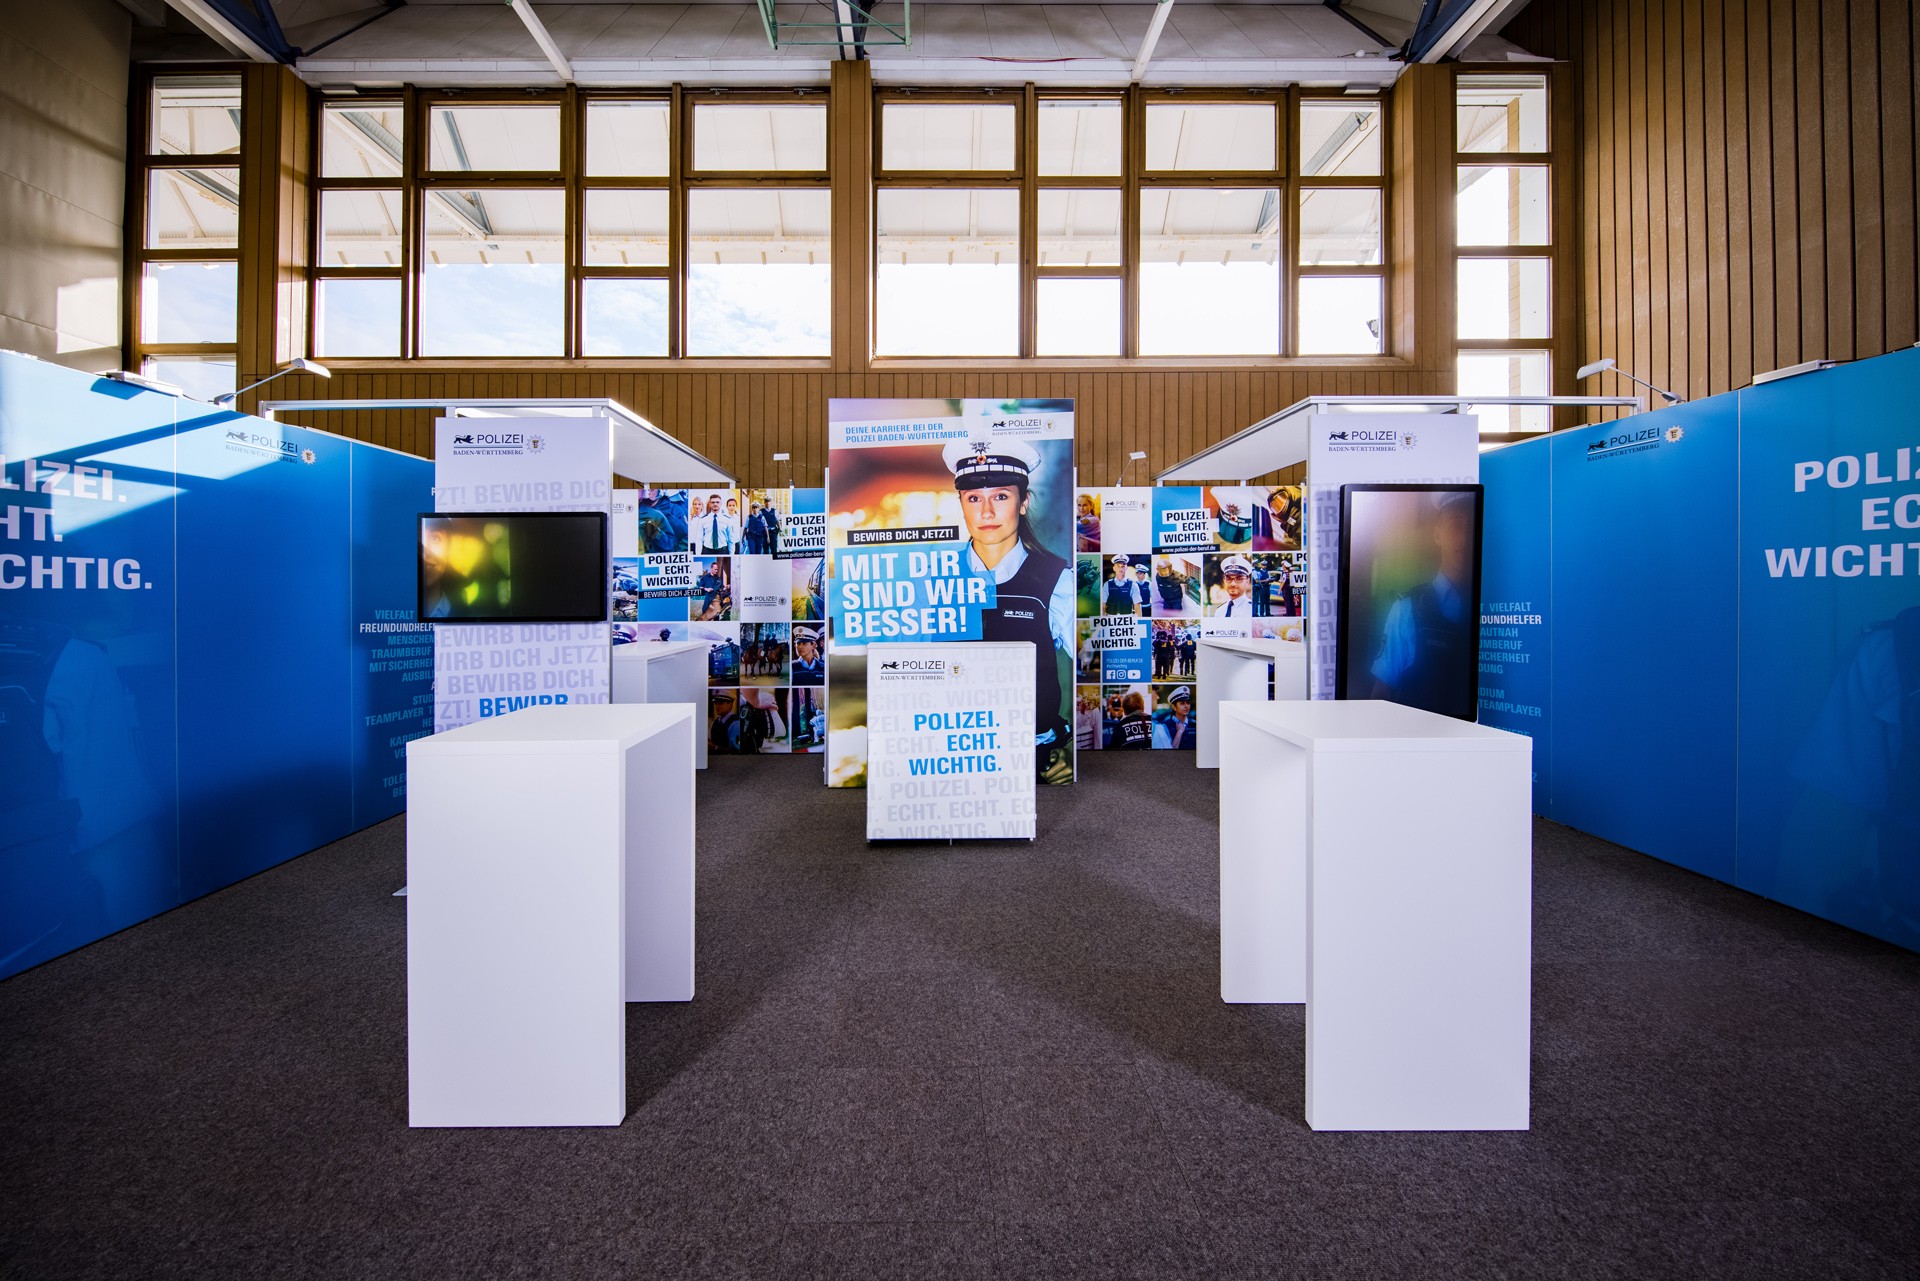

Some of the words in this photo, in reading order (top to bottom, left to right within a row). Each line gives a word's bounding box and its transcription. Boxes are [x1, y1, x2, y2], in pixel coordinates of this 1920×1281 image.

[1008, 419, 1042, 427] POLIZEI
[477, 434, 524, 444] POLIZEI
[846, 435, 875, 443] POLIZEI
[1352, 431, 1397, 440] POLIZEI
[1610, 428, 1660, 446] POLIZEI
[252, 434, 298, 453] POLIZEI
[1794, 446, 1920, 492] POLI
[475, 481, 564, 505] BEWIRB
[570, 480, 609, 500] DIC
[1166, 511, 1208, 521] POLIZEI.
[1183, 522, 1208, 531] ECHT.
[854, 530, 892, 542] BEWIRB
[895, 529, 919, 540] DICH
[922, 528, 953, 539] JETZT!
[1164, 532, 1209, 543] WICHTIG.
[648, 554, 691, 564] POLIZEI.
[842, 553, 898, 581] MIT
[908, 550, 960, 578] DIR
[0, 554, 152, 590] CHTIG.
[665, 565, 691, 574] ECHT.
[646, 576, 692, 586] WICHTIG.
[842, 580, 915, 610] SIND
[924, 578, 986, 606] WIR
[1489, 602, 1531, 612] VIELFALT
[375, 610, 414, 619] VIELFALT
[1480, 615, 1542, 624] DUNDHELFER
[360, 623, 434, 633] FREUNDUNDHELF
[844, 606, 966, 638] BESSER!
[1093, 617, 1136, 627] POLIZEI.
[436, 624, 514, 647] EWIRB
[520, 623, 571, 643] DICH
[1110, 628, 1136, 637] ECHT.
[1091, 638, 1136, 649] WICHTIG.
[372, 647, 431, 659] TRAUMBERUF
[490, 648, 540, 668] DICH
[369, 662, 387, 672] MIT
[902, 661, 945, 670] POLIZEI
[402, 670, 434, 682] AUSBIL
[448, 671, 536, 695] BEWIRB
[543, 669, 594, 690] DICH
[1480, 700, 1542, 718] TEAMPLAYER
[365, 707, 424, 726] TEAMPLAYER
[914, 710, 1000, 731] POLIZEI.
[886, 736, 939, 755] ECHT.
[947, 733, 1001, 751] ECHT.
[909, 755, 1002, 776] WICHTIG.
[383, 773, 406, 787] TOLE
[890, 779, 976, 800] POLIZEI.
[984, 776, 1034, 795] POLI
[887, 803, 941, 822] ECHT.
[950, 800, 1003, 819] ECHT.
